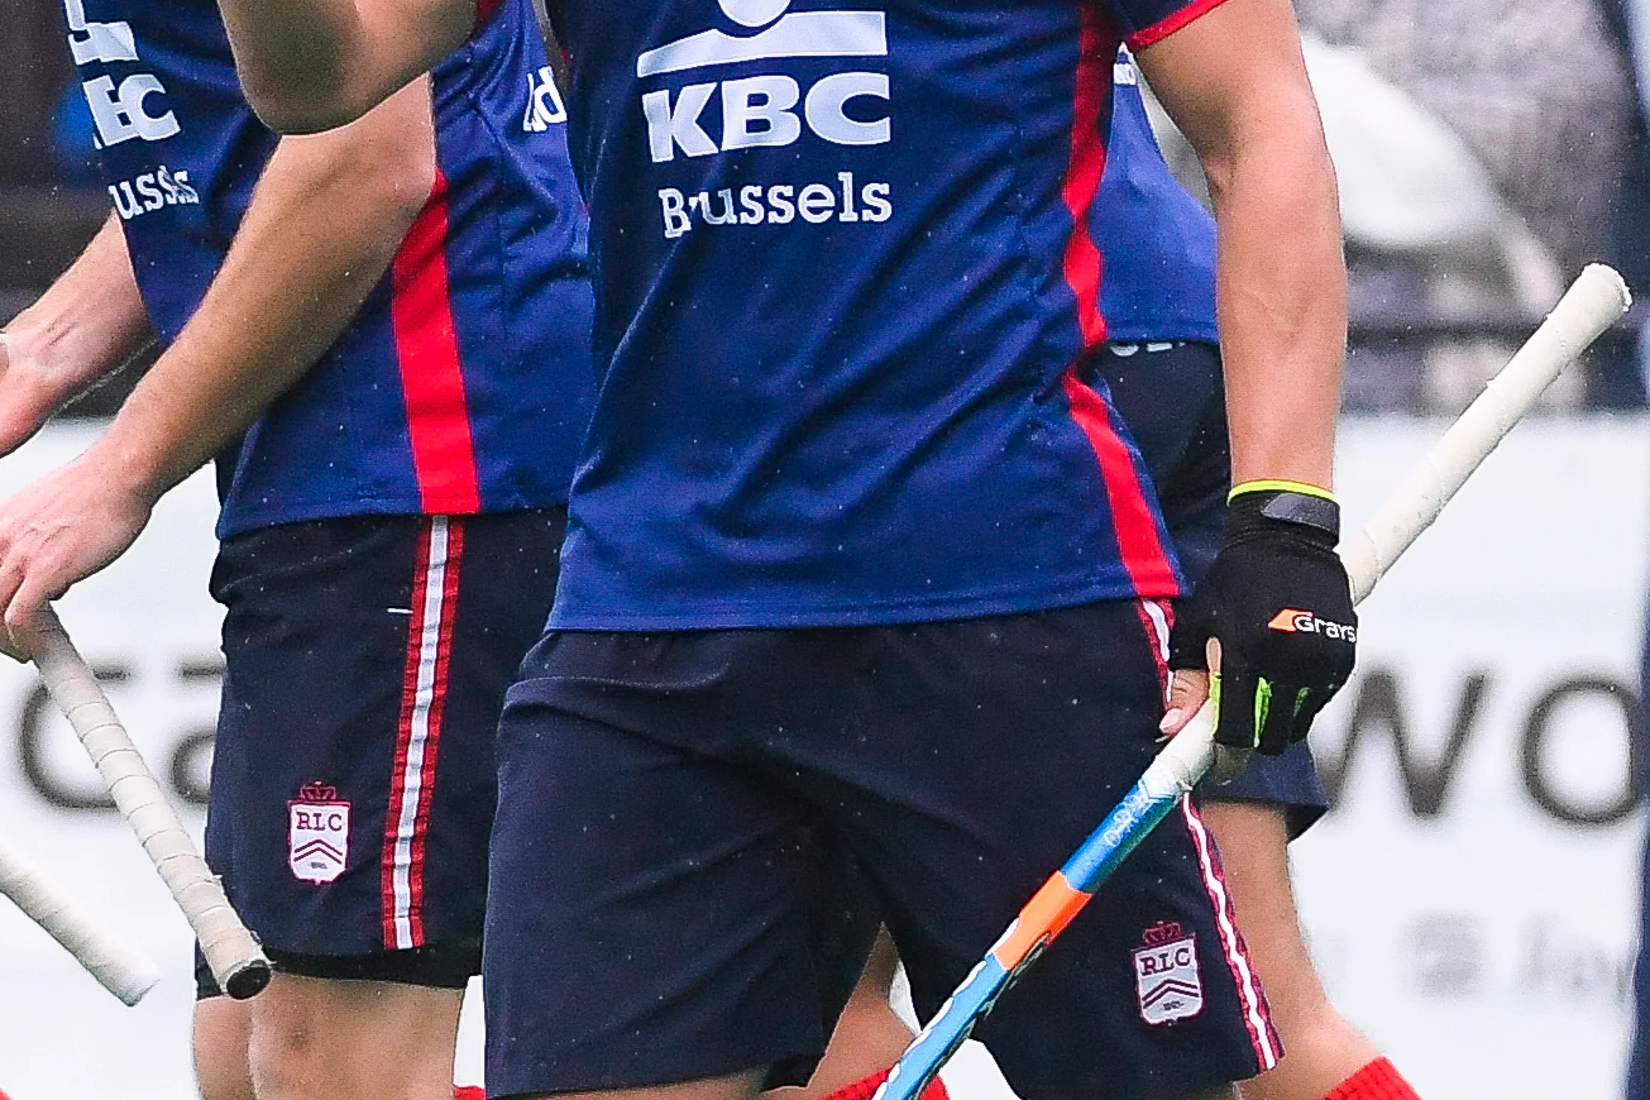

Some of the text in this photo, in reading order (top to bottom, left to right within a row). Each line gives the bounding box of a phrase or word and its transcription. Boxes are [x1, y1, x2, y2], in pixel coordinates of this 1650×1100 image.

[642, 71, 891, 163] KBC
[658, 171, 893, 238] Brussels
[1295, 613, 1356, 643] Grays
[296, 811, 343, 832] RLC
[1140, 947, 1191, 977] RLC
